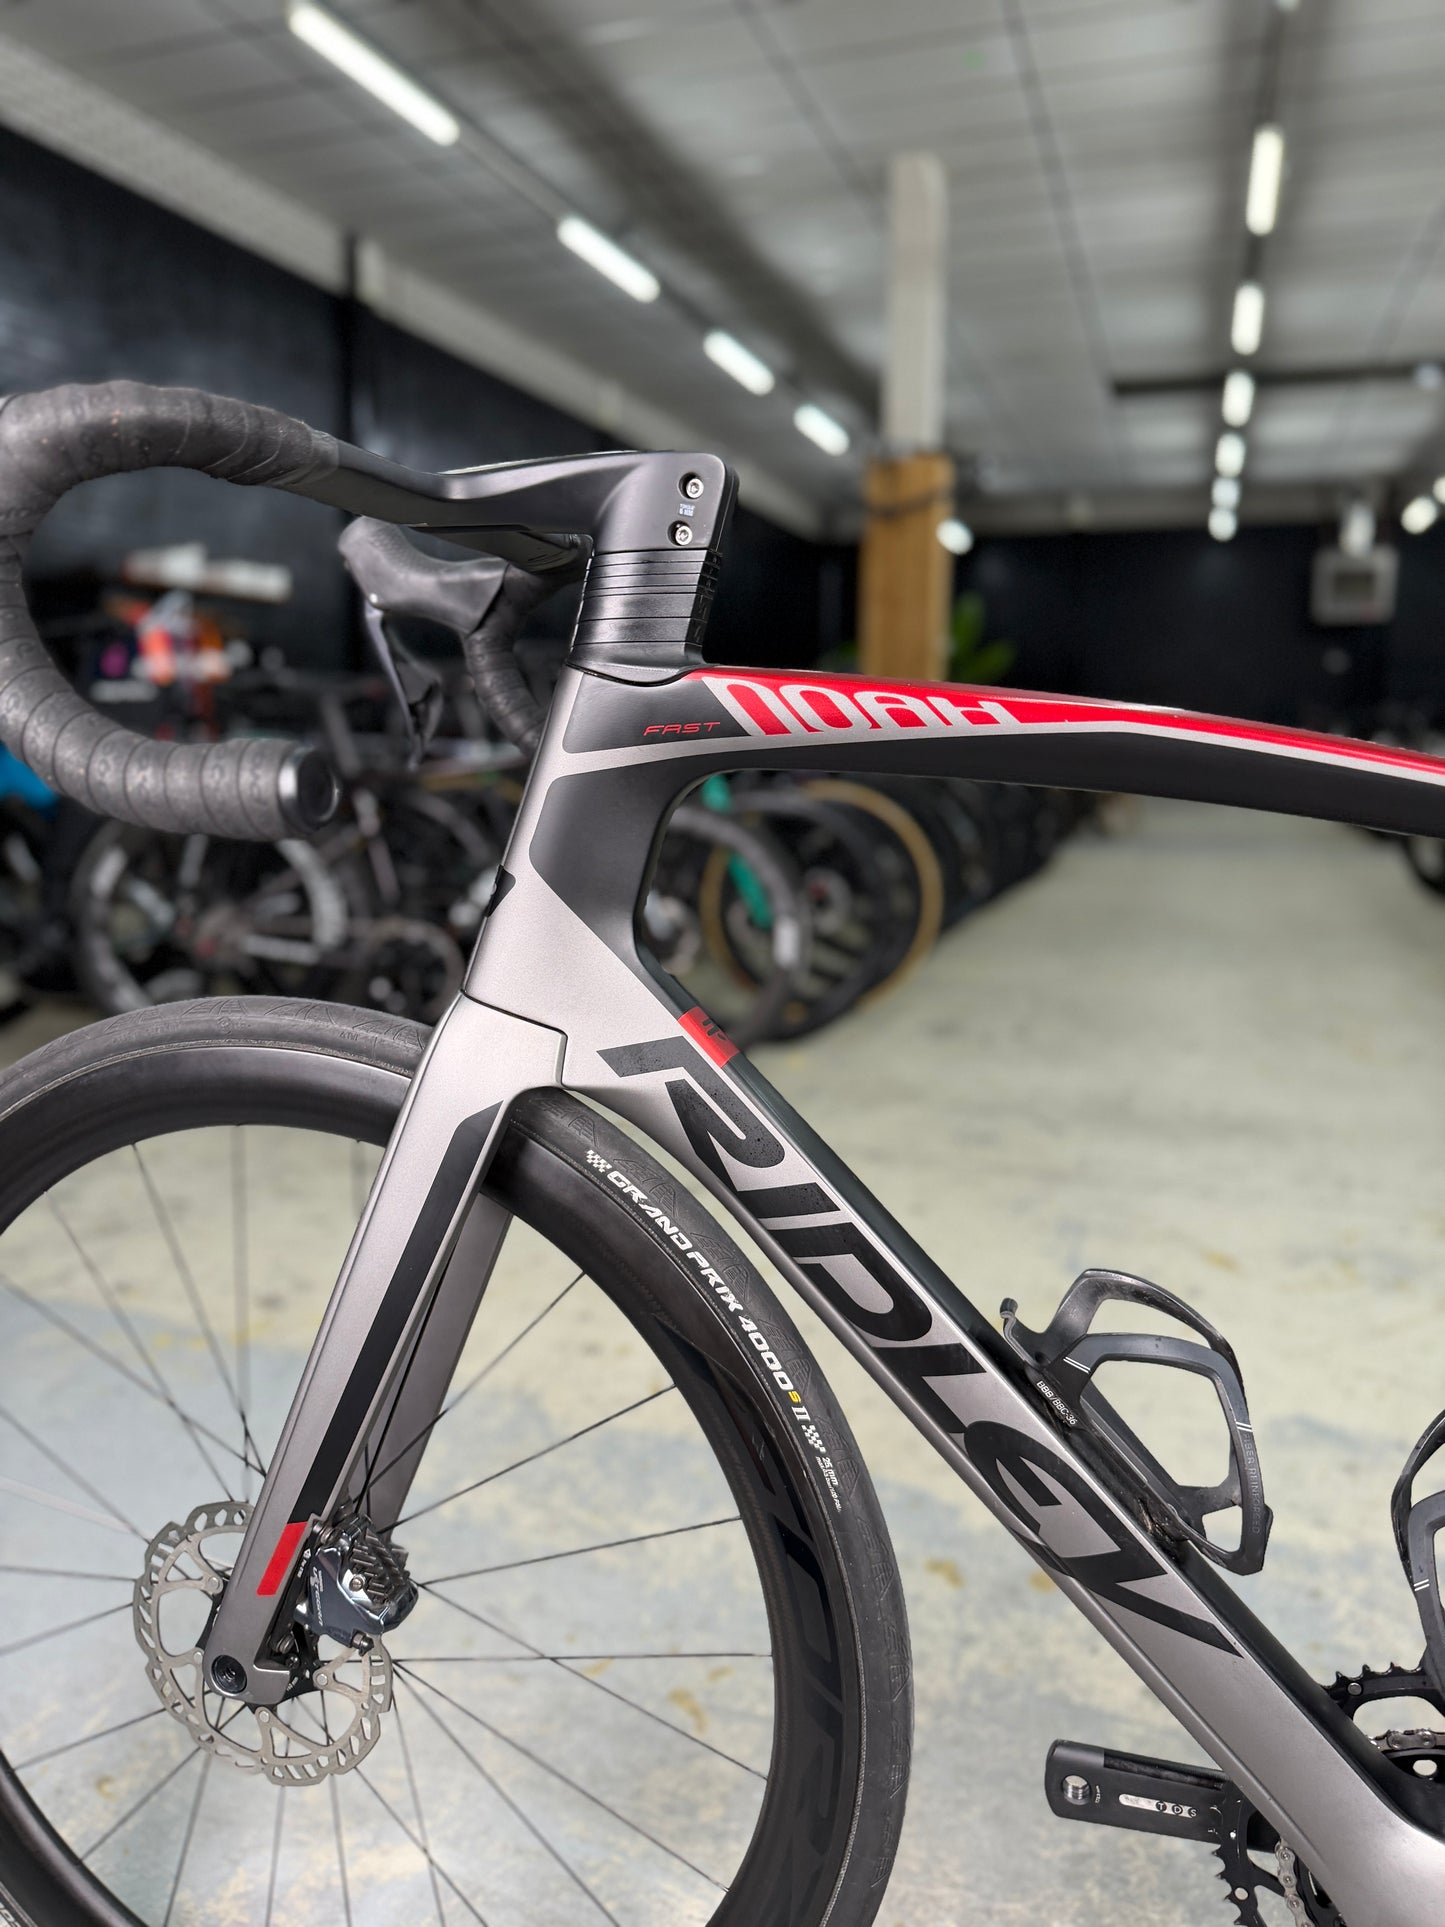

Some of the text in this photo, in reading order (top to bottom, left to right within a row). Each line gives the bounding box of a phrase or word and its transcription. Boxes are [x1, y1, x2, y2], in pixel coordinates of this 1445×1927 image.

[643, 722, 721, 736] FAST
[702, 677, 1019, 736] NOAH
[606, 1170, 693, 1251] GRAND
[686, 1251, 744, 1313] PRIX
[596, 1036, 1243, 1659] RIDLEY
[822, 1457, 833, 1469] 25
[1243, 1433, 1261, 1535] FIBER REINFORCED
